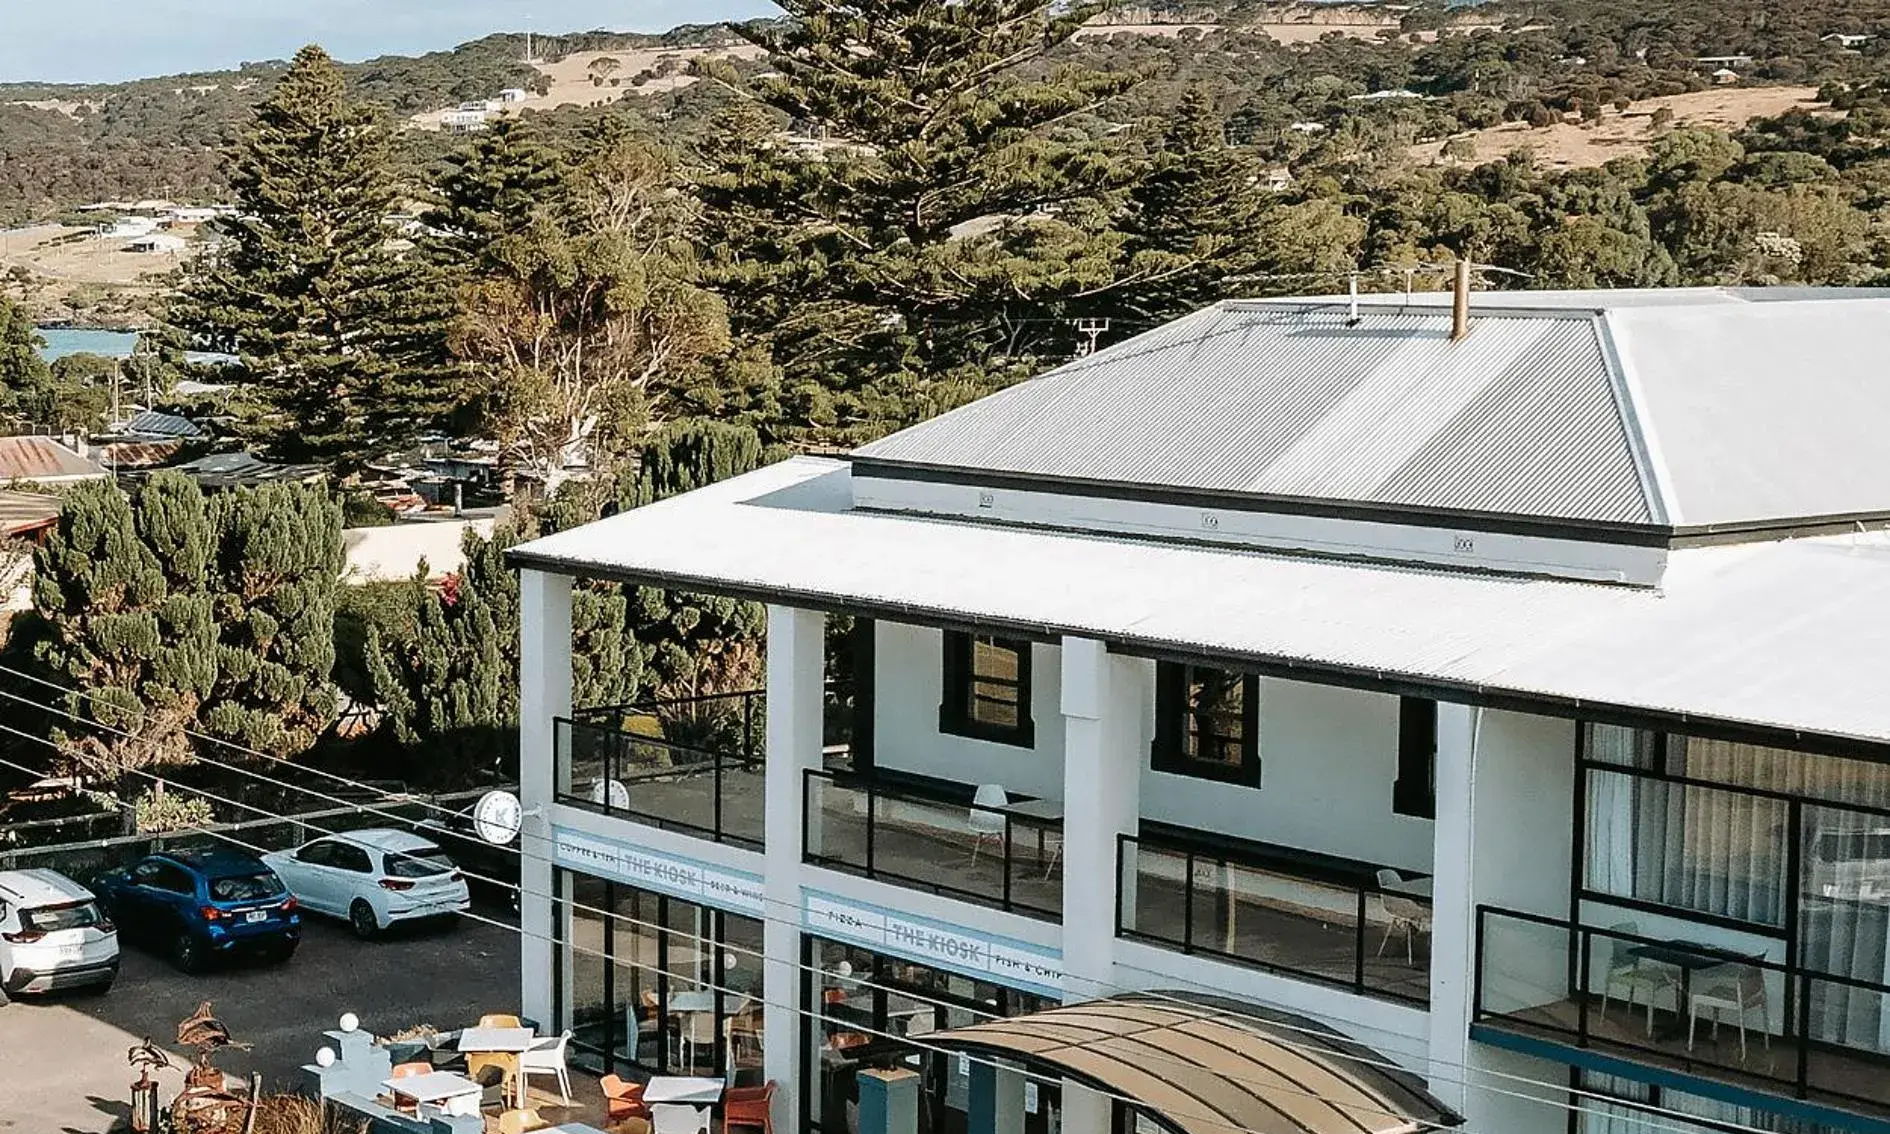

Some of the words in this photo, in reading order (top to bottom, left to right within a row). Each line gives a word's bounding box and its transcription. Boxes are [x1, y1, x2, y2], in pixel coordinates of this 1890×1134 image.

[624, 854, 650, 875] THE
[654, 862, 697, 887] KIOSK
[828, 911, 863, 929] PIZZA
[893, 923, 924, 946] THE
[929, 933, 980, 963] KIOSK
